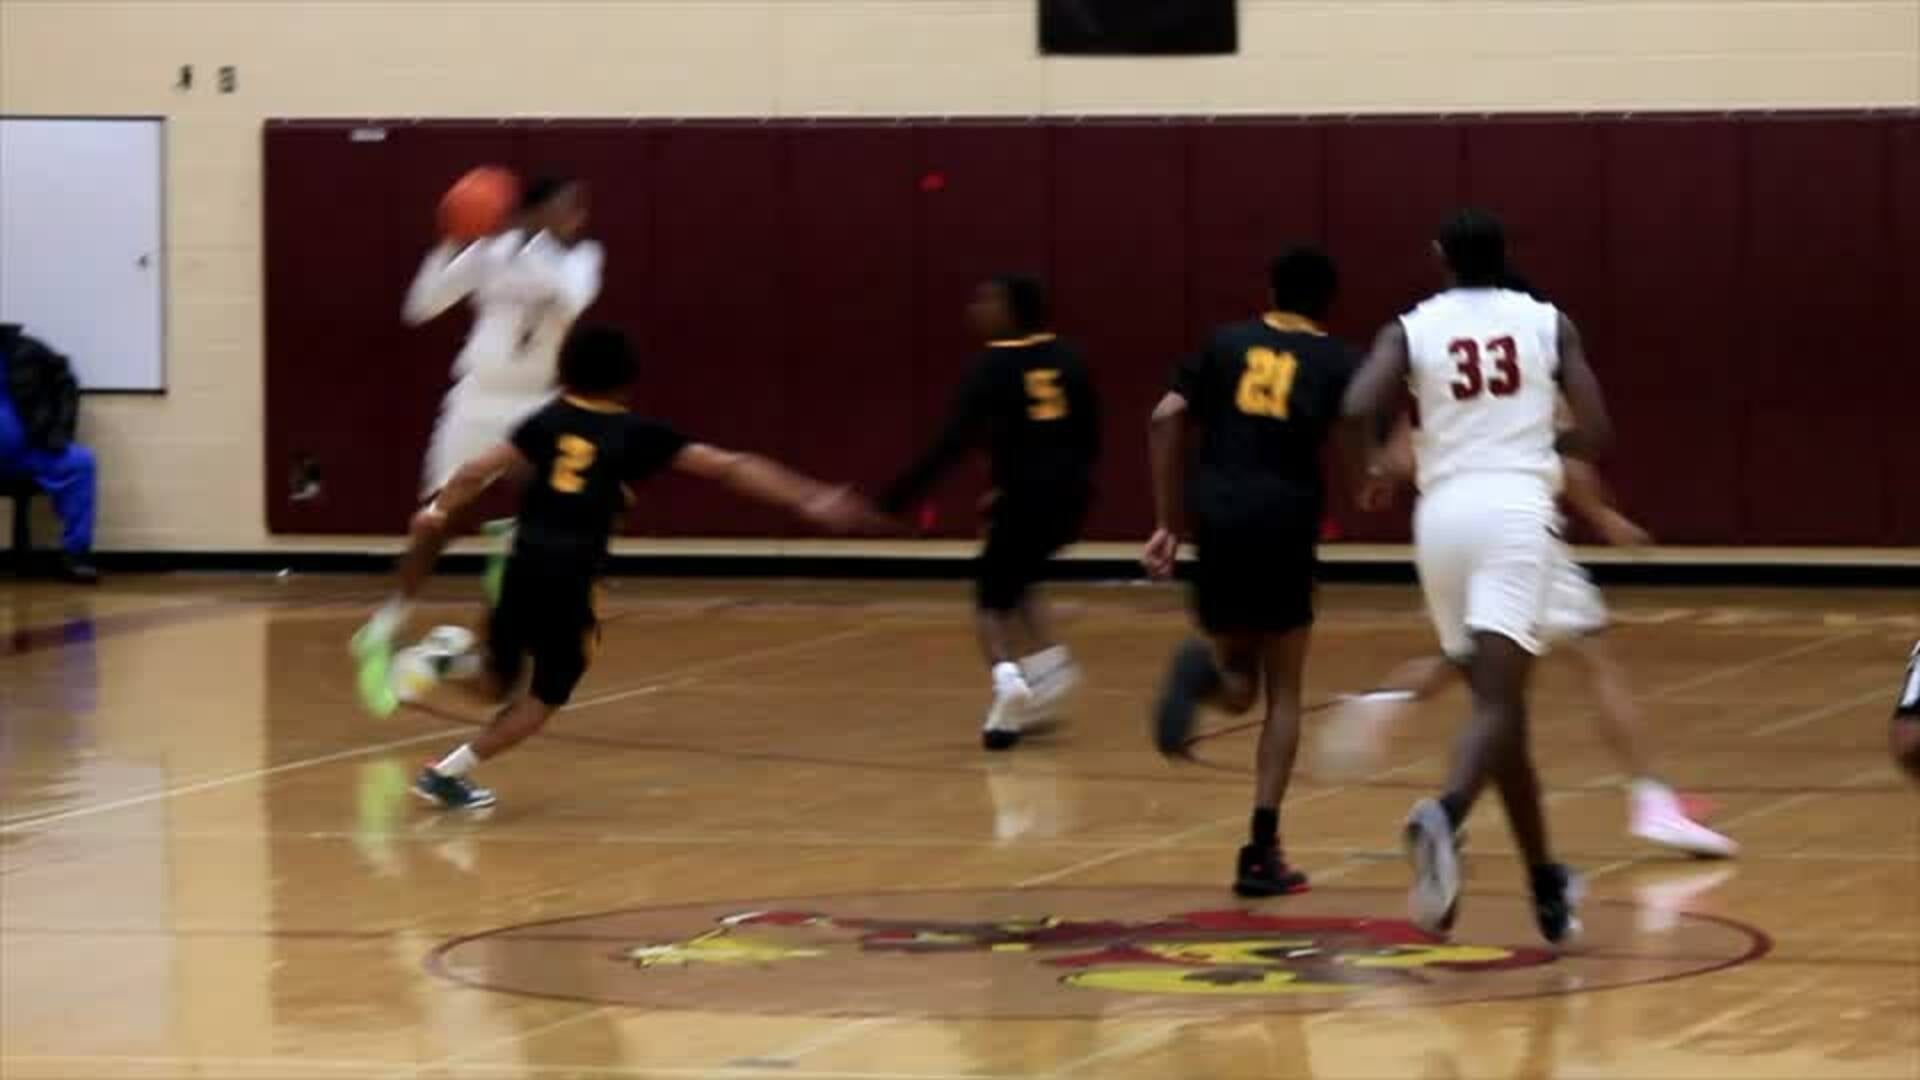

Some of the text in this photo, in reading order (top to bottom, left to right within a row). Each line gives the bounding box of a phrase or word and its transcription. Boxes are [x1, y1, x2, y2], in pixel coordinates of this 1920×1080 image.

[1025, 370, 1066, 420] 5
[1236, 346, 1296, 419] 21
[1448, 336, 1521, 400] 33
[551, 434, 596, 493] 2
